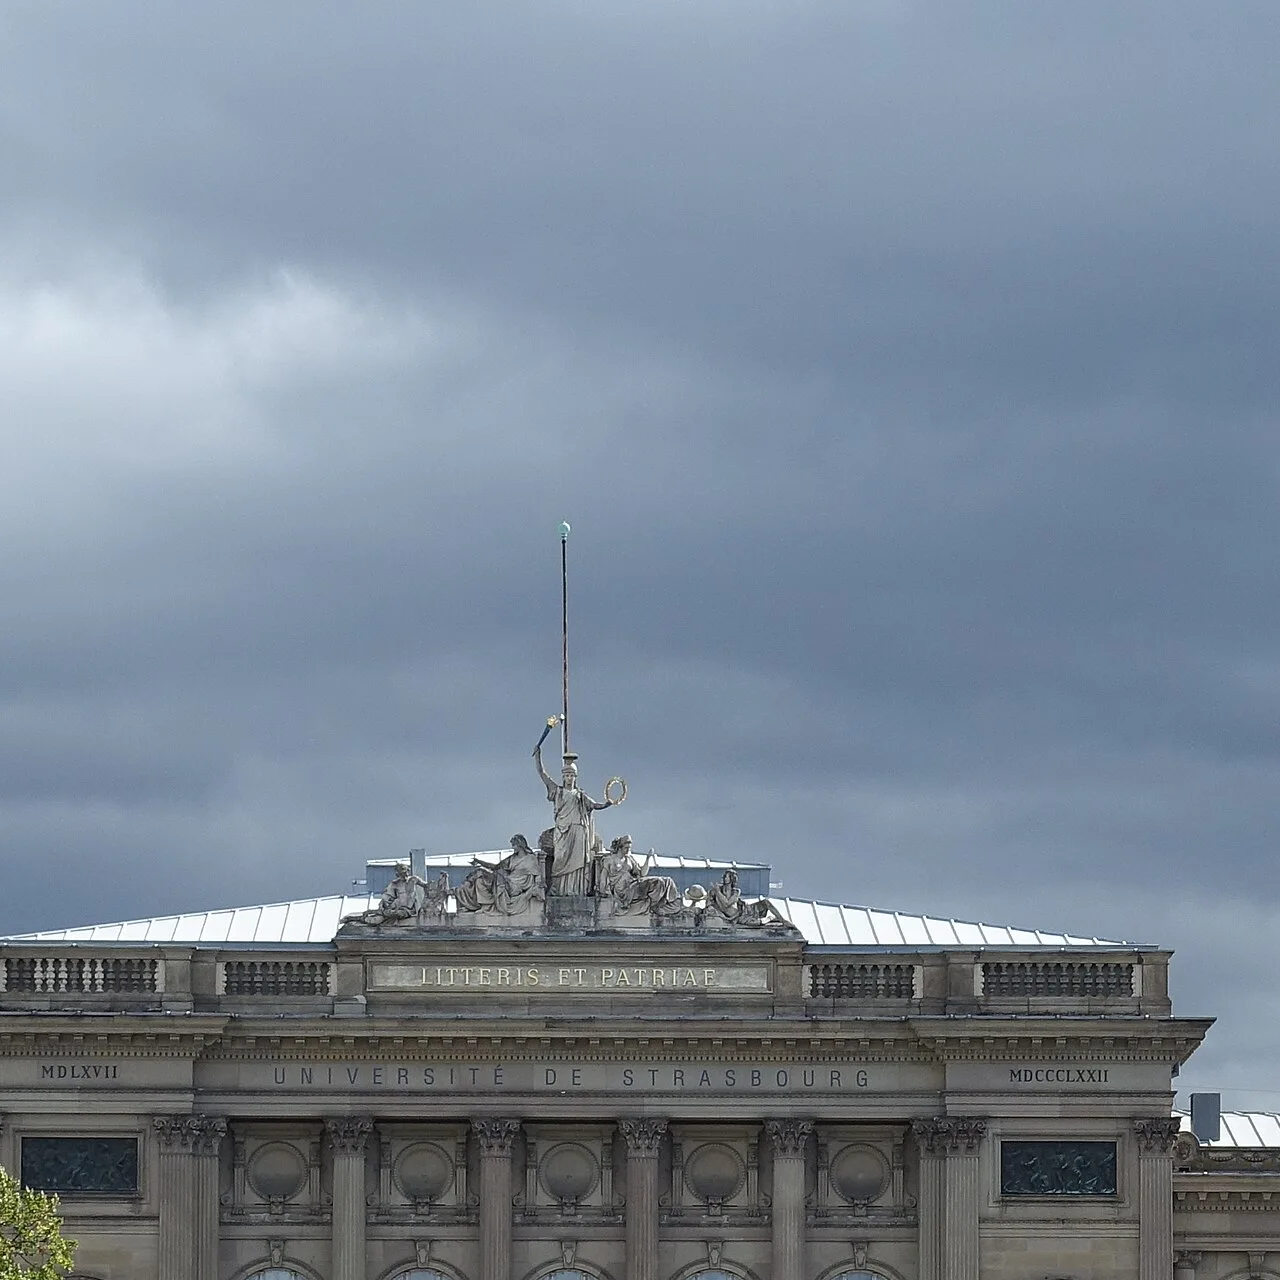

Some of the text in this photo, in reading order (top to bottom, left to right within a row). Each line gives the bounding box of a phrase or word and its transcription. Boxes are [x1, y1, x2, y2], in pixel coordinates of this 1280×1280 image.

[421, 968, 717, 987] LITTERIS ET PATRIAE
[41, 1064, 118, 1080] MDLXVII
[273, 1064, 869, 1087] UNIVERSITÉ DE STRASBOURG
[1009, 1069, 1109, 1083] MDCCCLXXII
